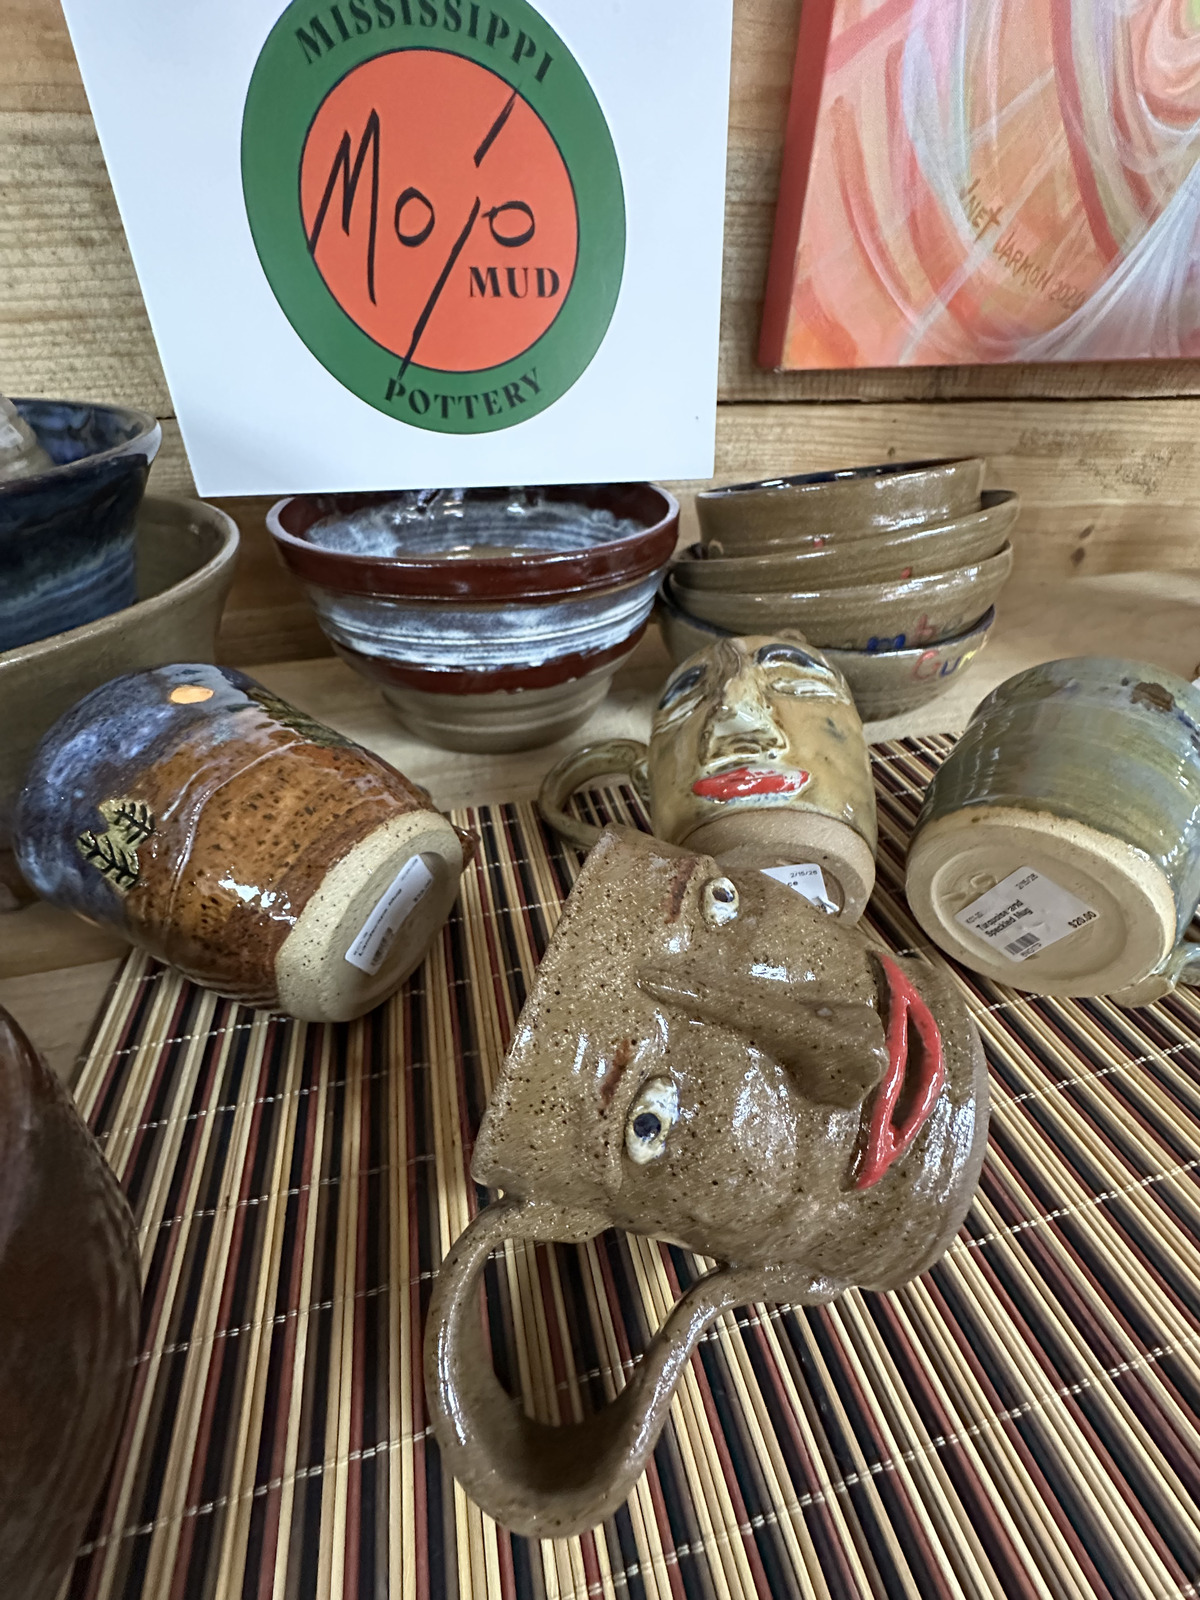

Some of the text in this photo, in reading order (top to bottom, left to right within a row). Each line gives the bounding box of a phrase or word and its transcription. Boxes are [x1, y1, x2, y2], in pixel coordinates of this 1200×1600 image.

[294, 0, 554, 85] MISSISSIPPI
[469, 266, 560, 299] MUD
[385, 367, 542, 420] POTTERY
[1007, 899, 1024, 912] and
[1068, 910, 1098, 929] $20.00
[984, 916, 1016, 937] Speckled
[1014, 907, 1034, 920] Mug
